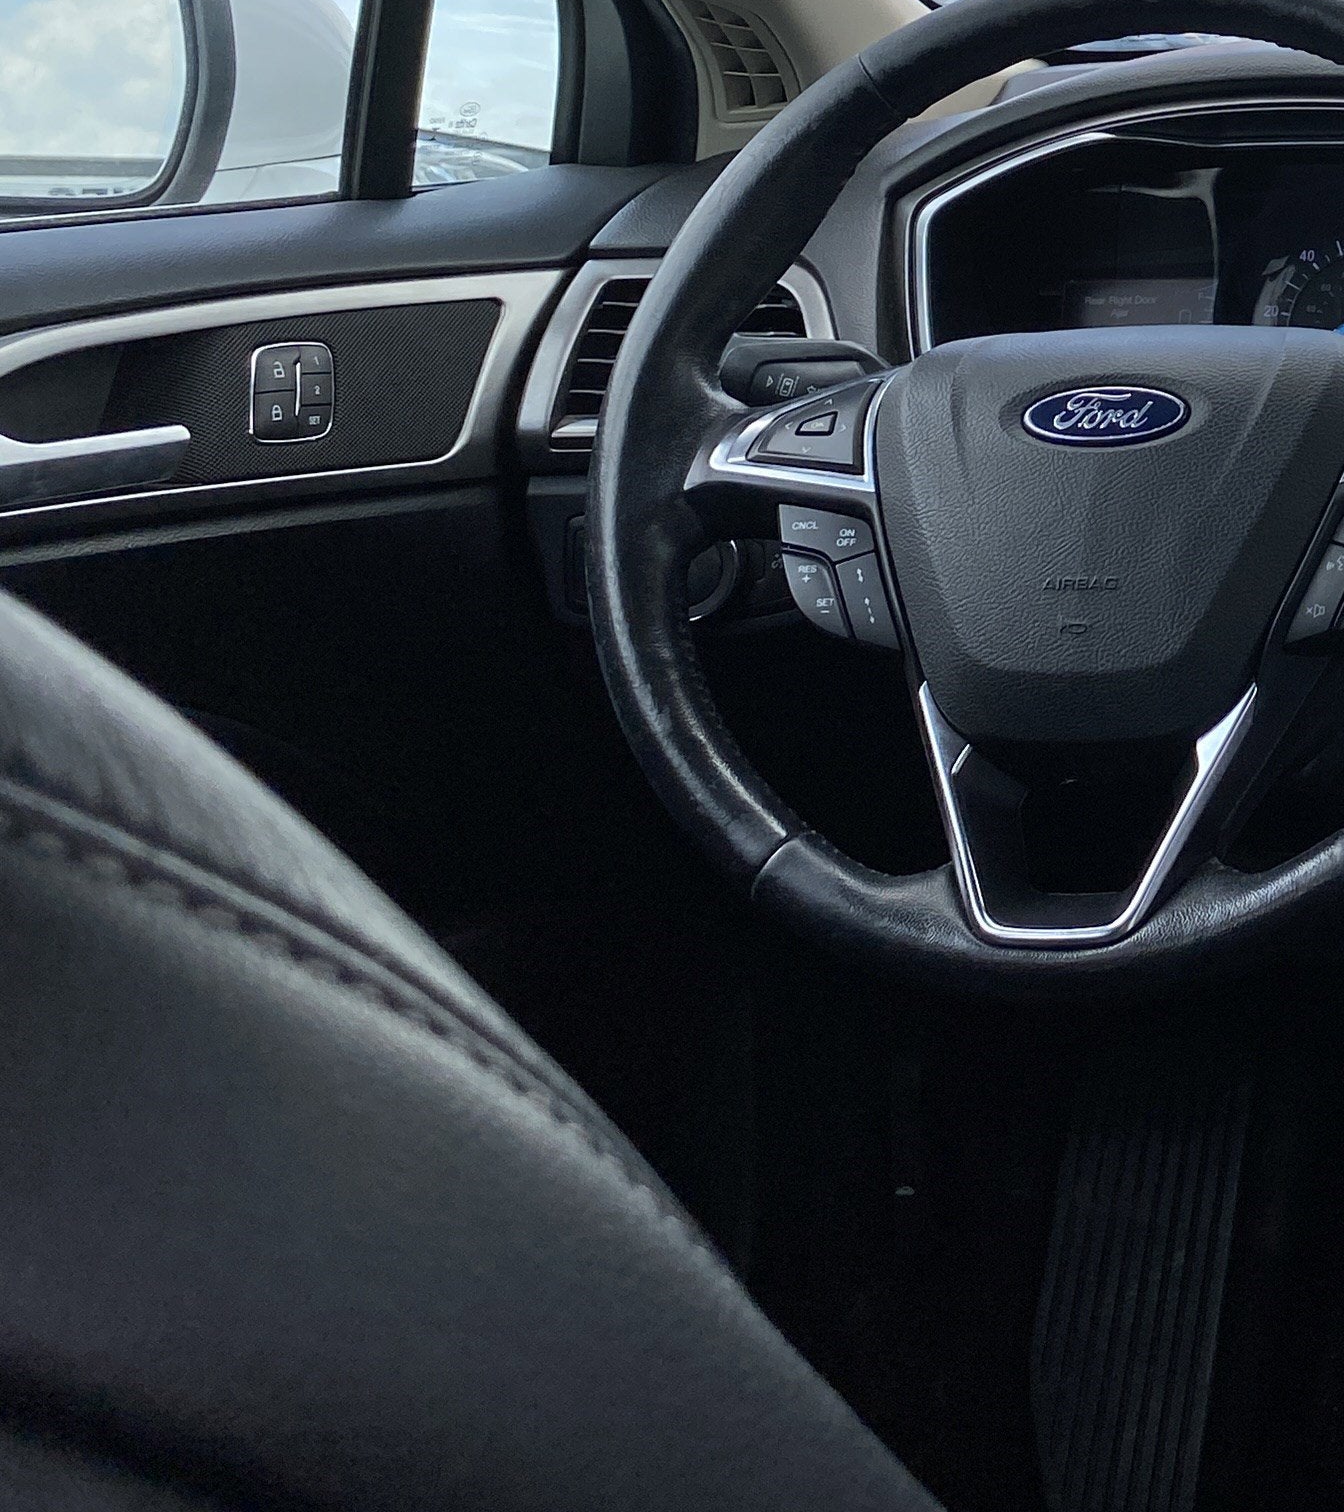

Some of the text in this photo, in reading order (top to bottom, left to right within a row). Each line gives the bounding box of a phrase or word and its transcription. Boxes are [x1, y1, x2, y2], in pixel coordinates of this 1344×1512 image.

[1300, 250, 1315, 262] 40
[1264, 305, 1279, 317] 20
[1053, 392, 1154, 431] Ford
[792, 522, 820, 531] CNCL
[839, 529, 855, 537] ON
[836, 539, 856, 547] OFF
[798, 565, 818, 573] RES
[1043, 577, 1119, 590] AIRBAG
[816, 599, 835, 607] SET
